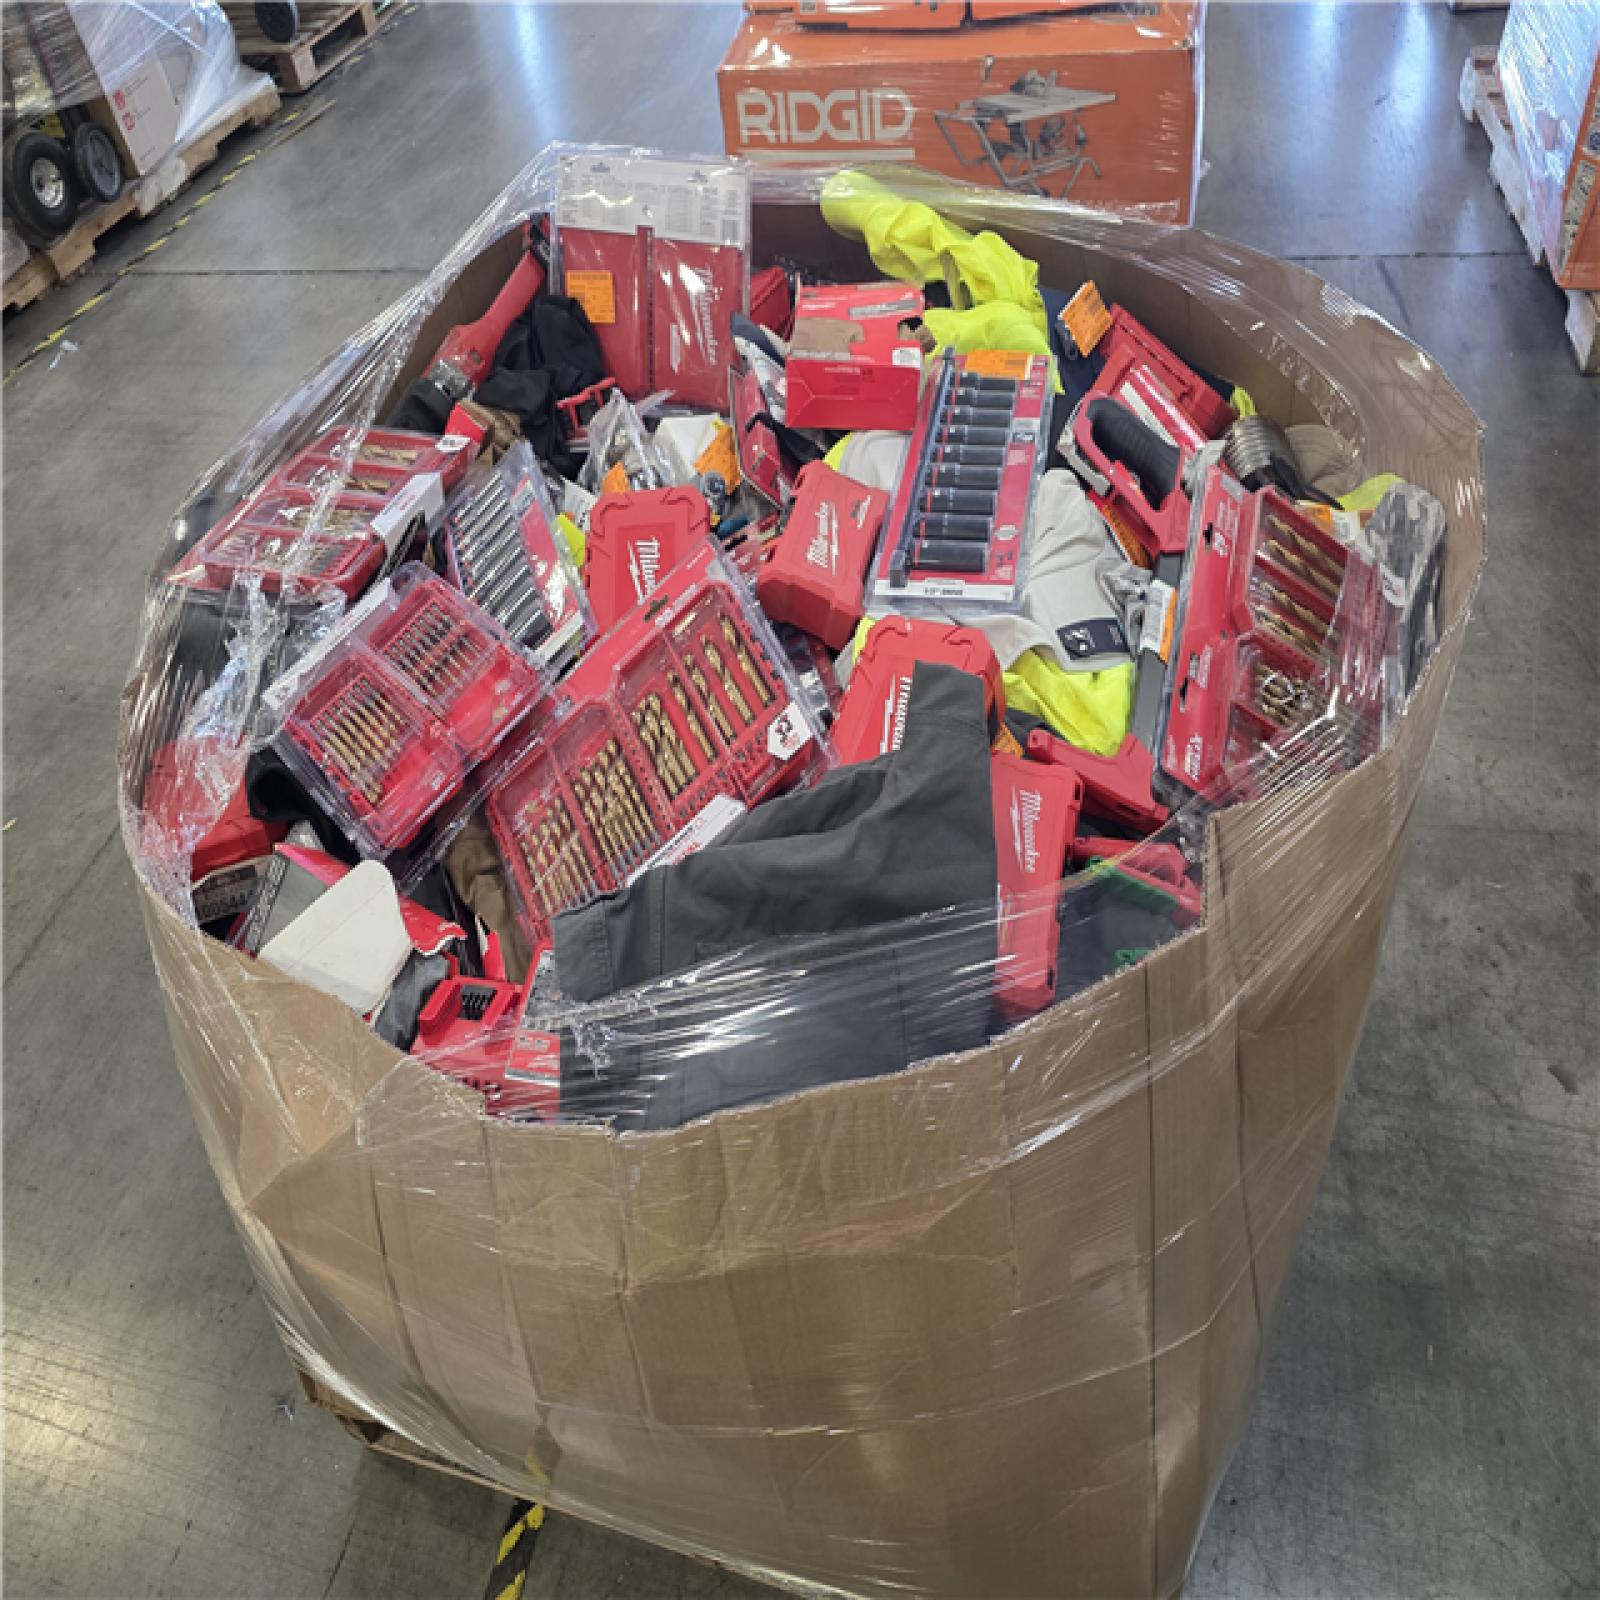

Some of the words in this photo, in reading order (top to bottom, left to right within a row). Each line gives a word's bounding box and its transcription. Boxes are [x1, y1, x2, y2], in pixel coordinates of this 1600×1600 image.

[736, 88, 917, 143] RIDGID
[806, 501, 829, 568] Milwaukee
[1019, 789, 1042, 873] Milwaukee
